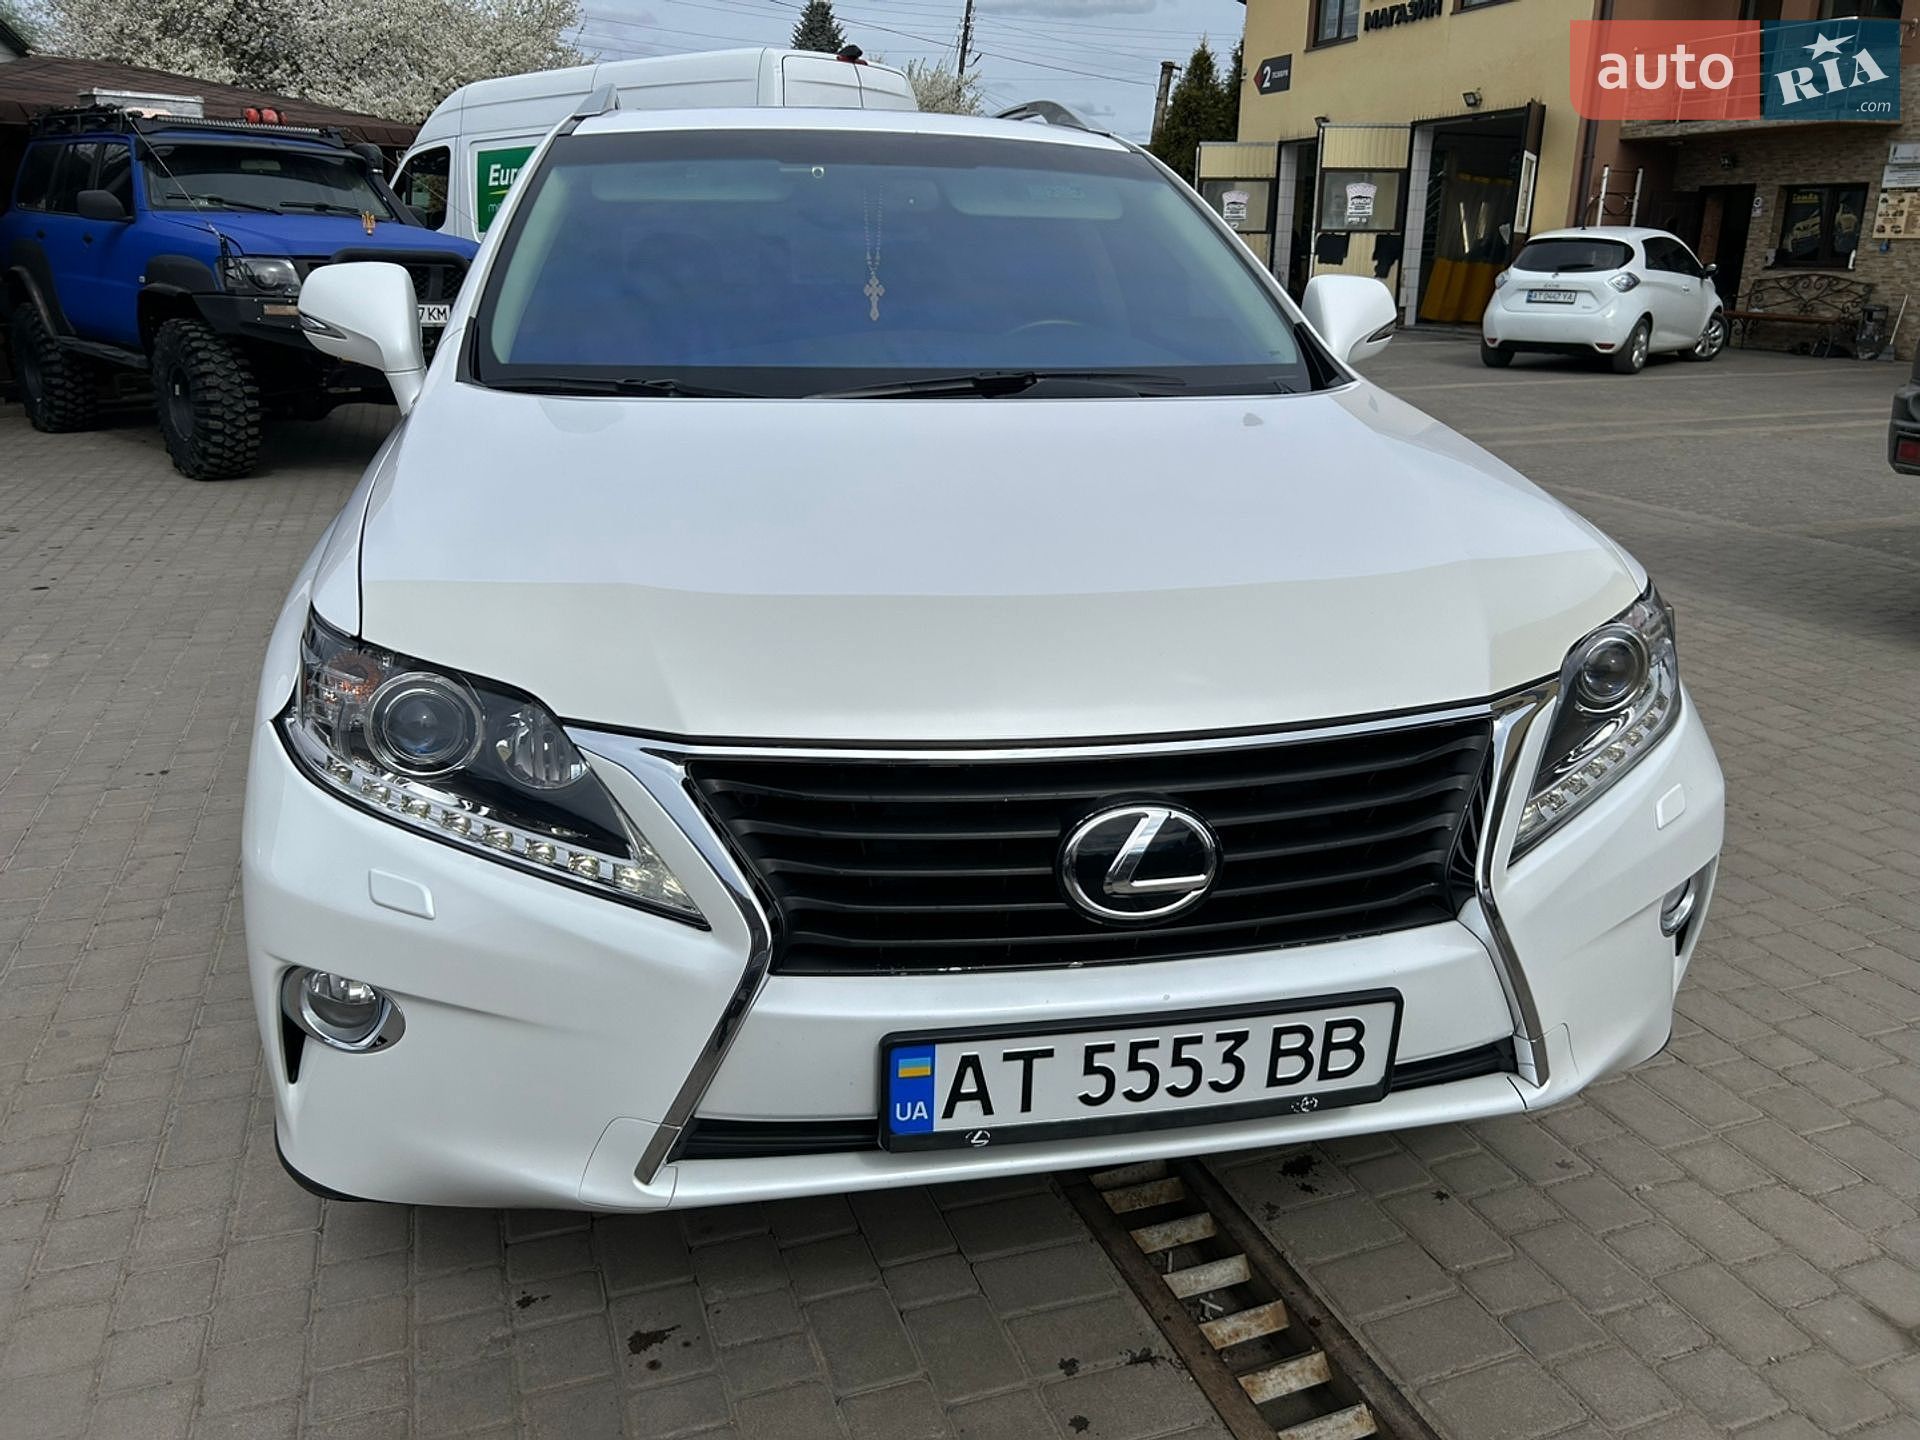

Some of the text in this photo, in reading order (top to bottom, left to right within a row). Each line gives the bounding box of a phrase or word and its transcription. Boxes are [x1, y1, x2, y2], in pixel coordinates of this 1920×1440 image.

[1363, 0, 1443, 31] МАГАЗИН
[1262, 65, 1271, 88] 2
[488, 163, 519, 186] Eur
[427, 306, 448, 321] KM
[941, 1017, 1367, 1120] AT 5553 BB
[895, 1103, 929, 1122] UA
